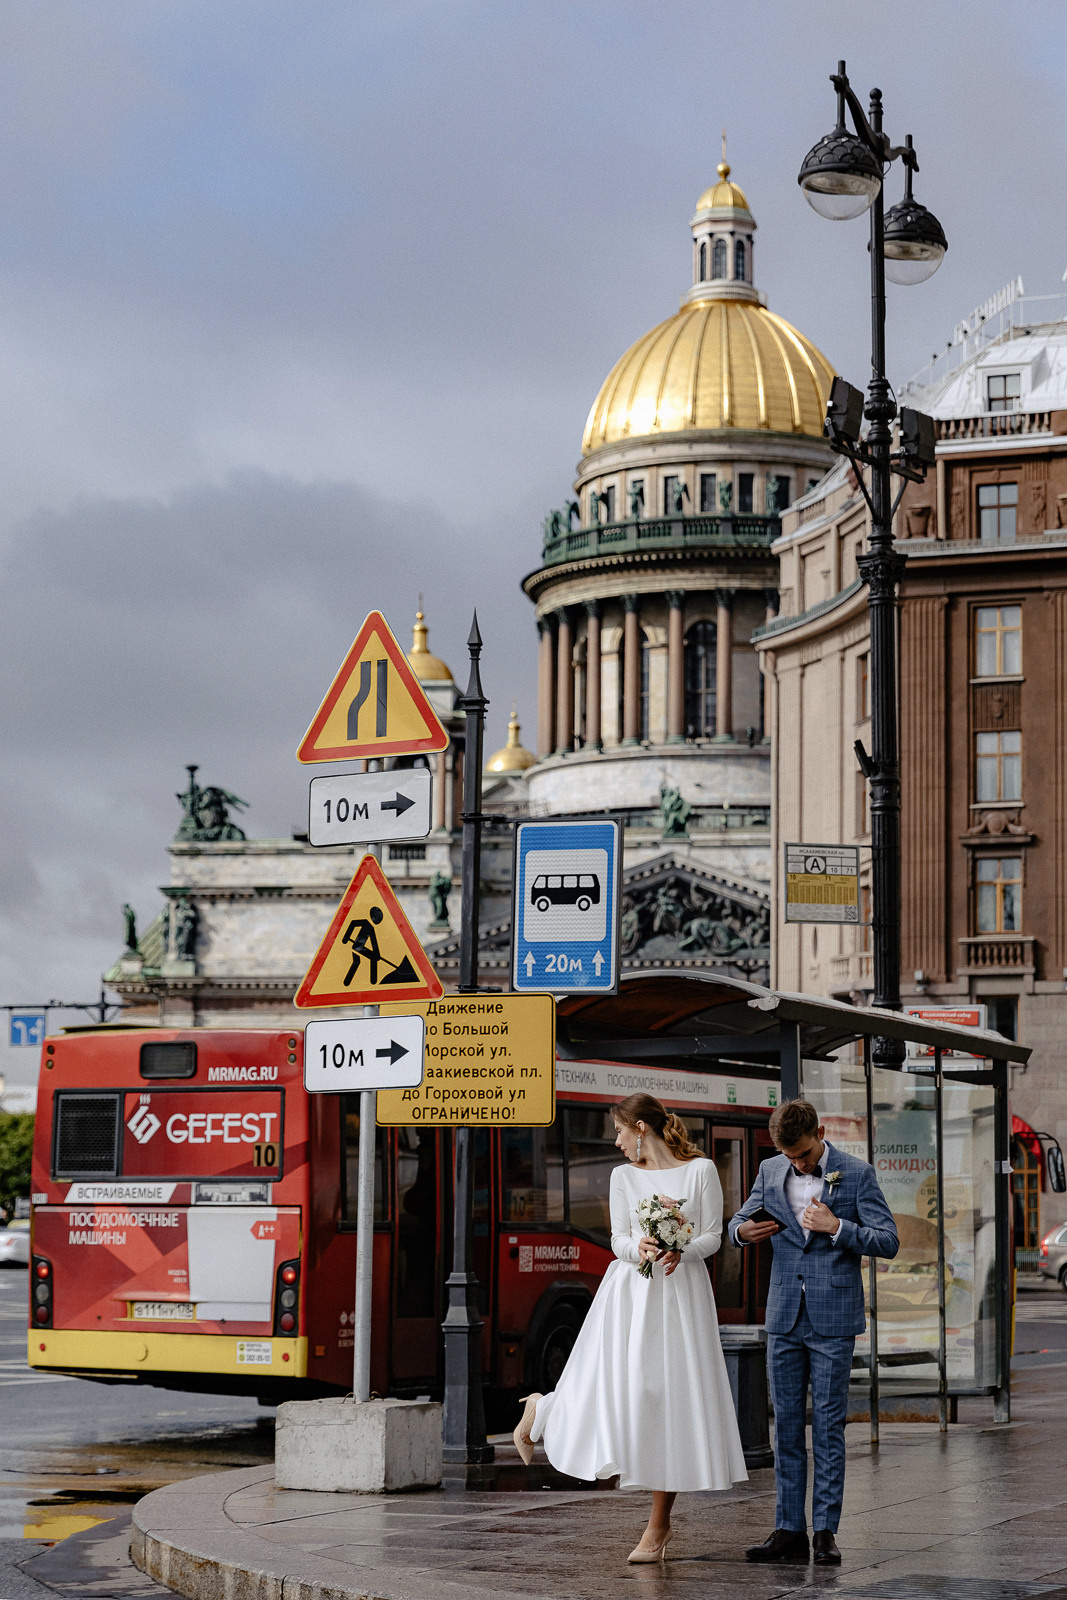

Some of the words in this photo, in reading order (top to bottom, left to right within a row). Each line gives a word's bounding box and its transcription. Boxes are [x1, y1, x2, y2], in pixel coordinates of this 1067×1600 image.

[323, 797, 369, 823] 10м
[544, 953, 583, 973] 20м
[426, 1002, 504, 1016] Движение
[443, 1022, 509, 1035] Большой
[319, 1043, 364, 1069] 10м
[490, 1046, 512, 1060] ул.
[208, 1066, 278, 1081] MRMAG.RU
[426, 1065, 514, 1078] аакиевской
[520, 1068, 543, 1078] пл.
[561, 1068, 597, 1085] ТЕХНИКА
[607, 1073, 675, 1092] ПОСУДОМОЕЧНЫЕ
[675, 1080, 709, 1094] МАШИНЫ
[402, 1089, 420, 1101] до
[426, 1086, 503, 1102] Гороховой
[509, 1089, 526, 1102] ул
[412, 1107, 515, 1120] ОГРАНИЧЕНО!
[166, 1112, 278, 1144] GEFEST
[255, 1145, 275, 1167] 10
[77, 1187, 163, 1199] ВСТРАИВАЕМЫЕ
[69, 1212, 179, 1229] ПОСУДОМОЕЧНЫЕ
[68, 1230, 127, 1245] МАШИНЫ
[534, 1246, 580, 1259] MRMAG.RU
